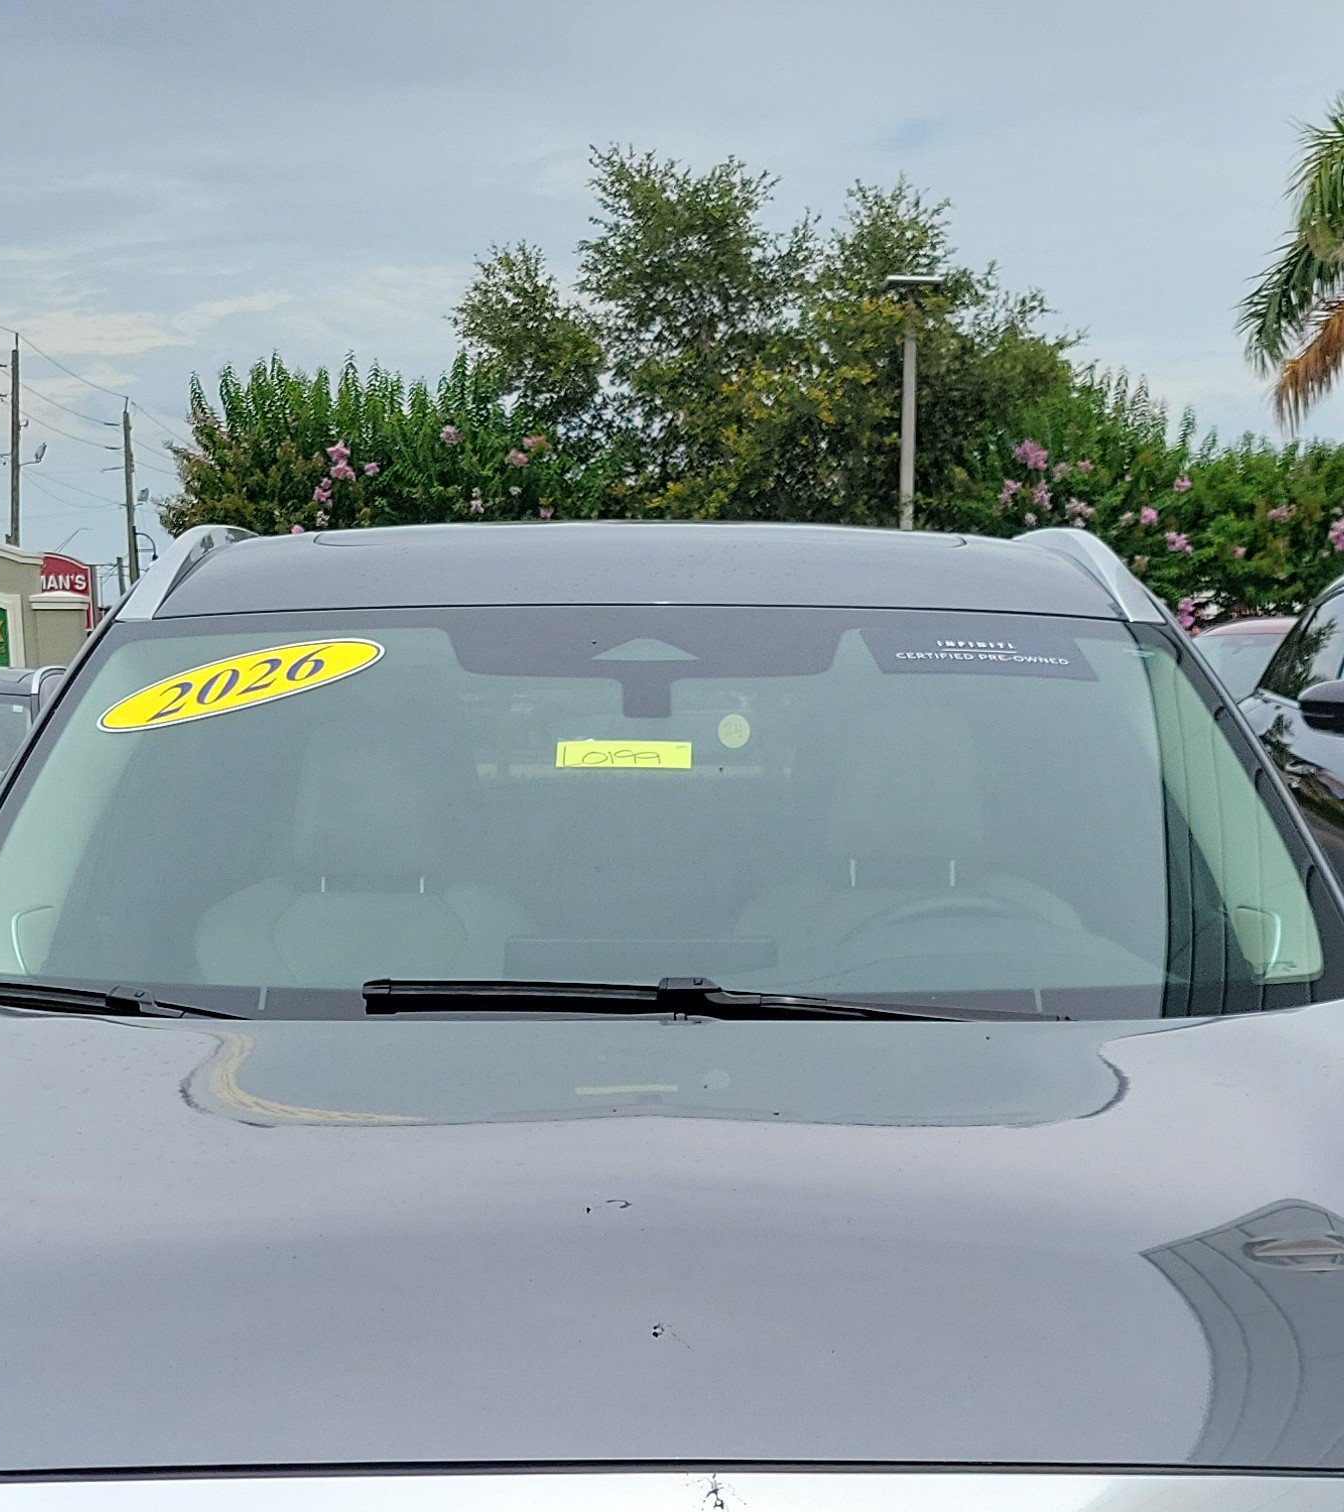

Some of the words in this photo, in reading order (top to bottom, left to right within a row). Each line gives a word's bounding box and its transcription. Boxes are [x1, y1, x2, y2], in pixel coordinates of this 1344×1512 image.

[896, 652, 973, 661] CERTIFIED
[978, 653, 1069, 665] PRE-OWNED
[145, 645, 333, 723] 2026
